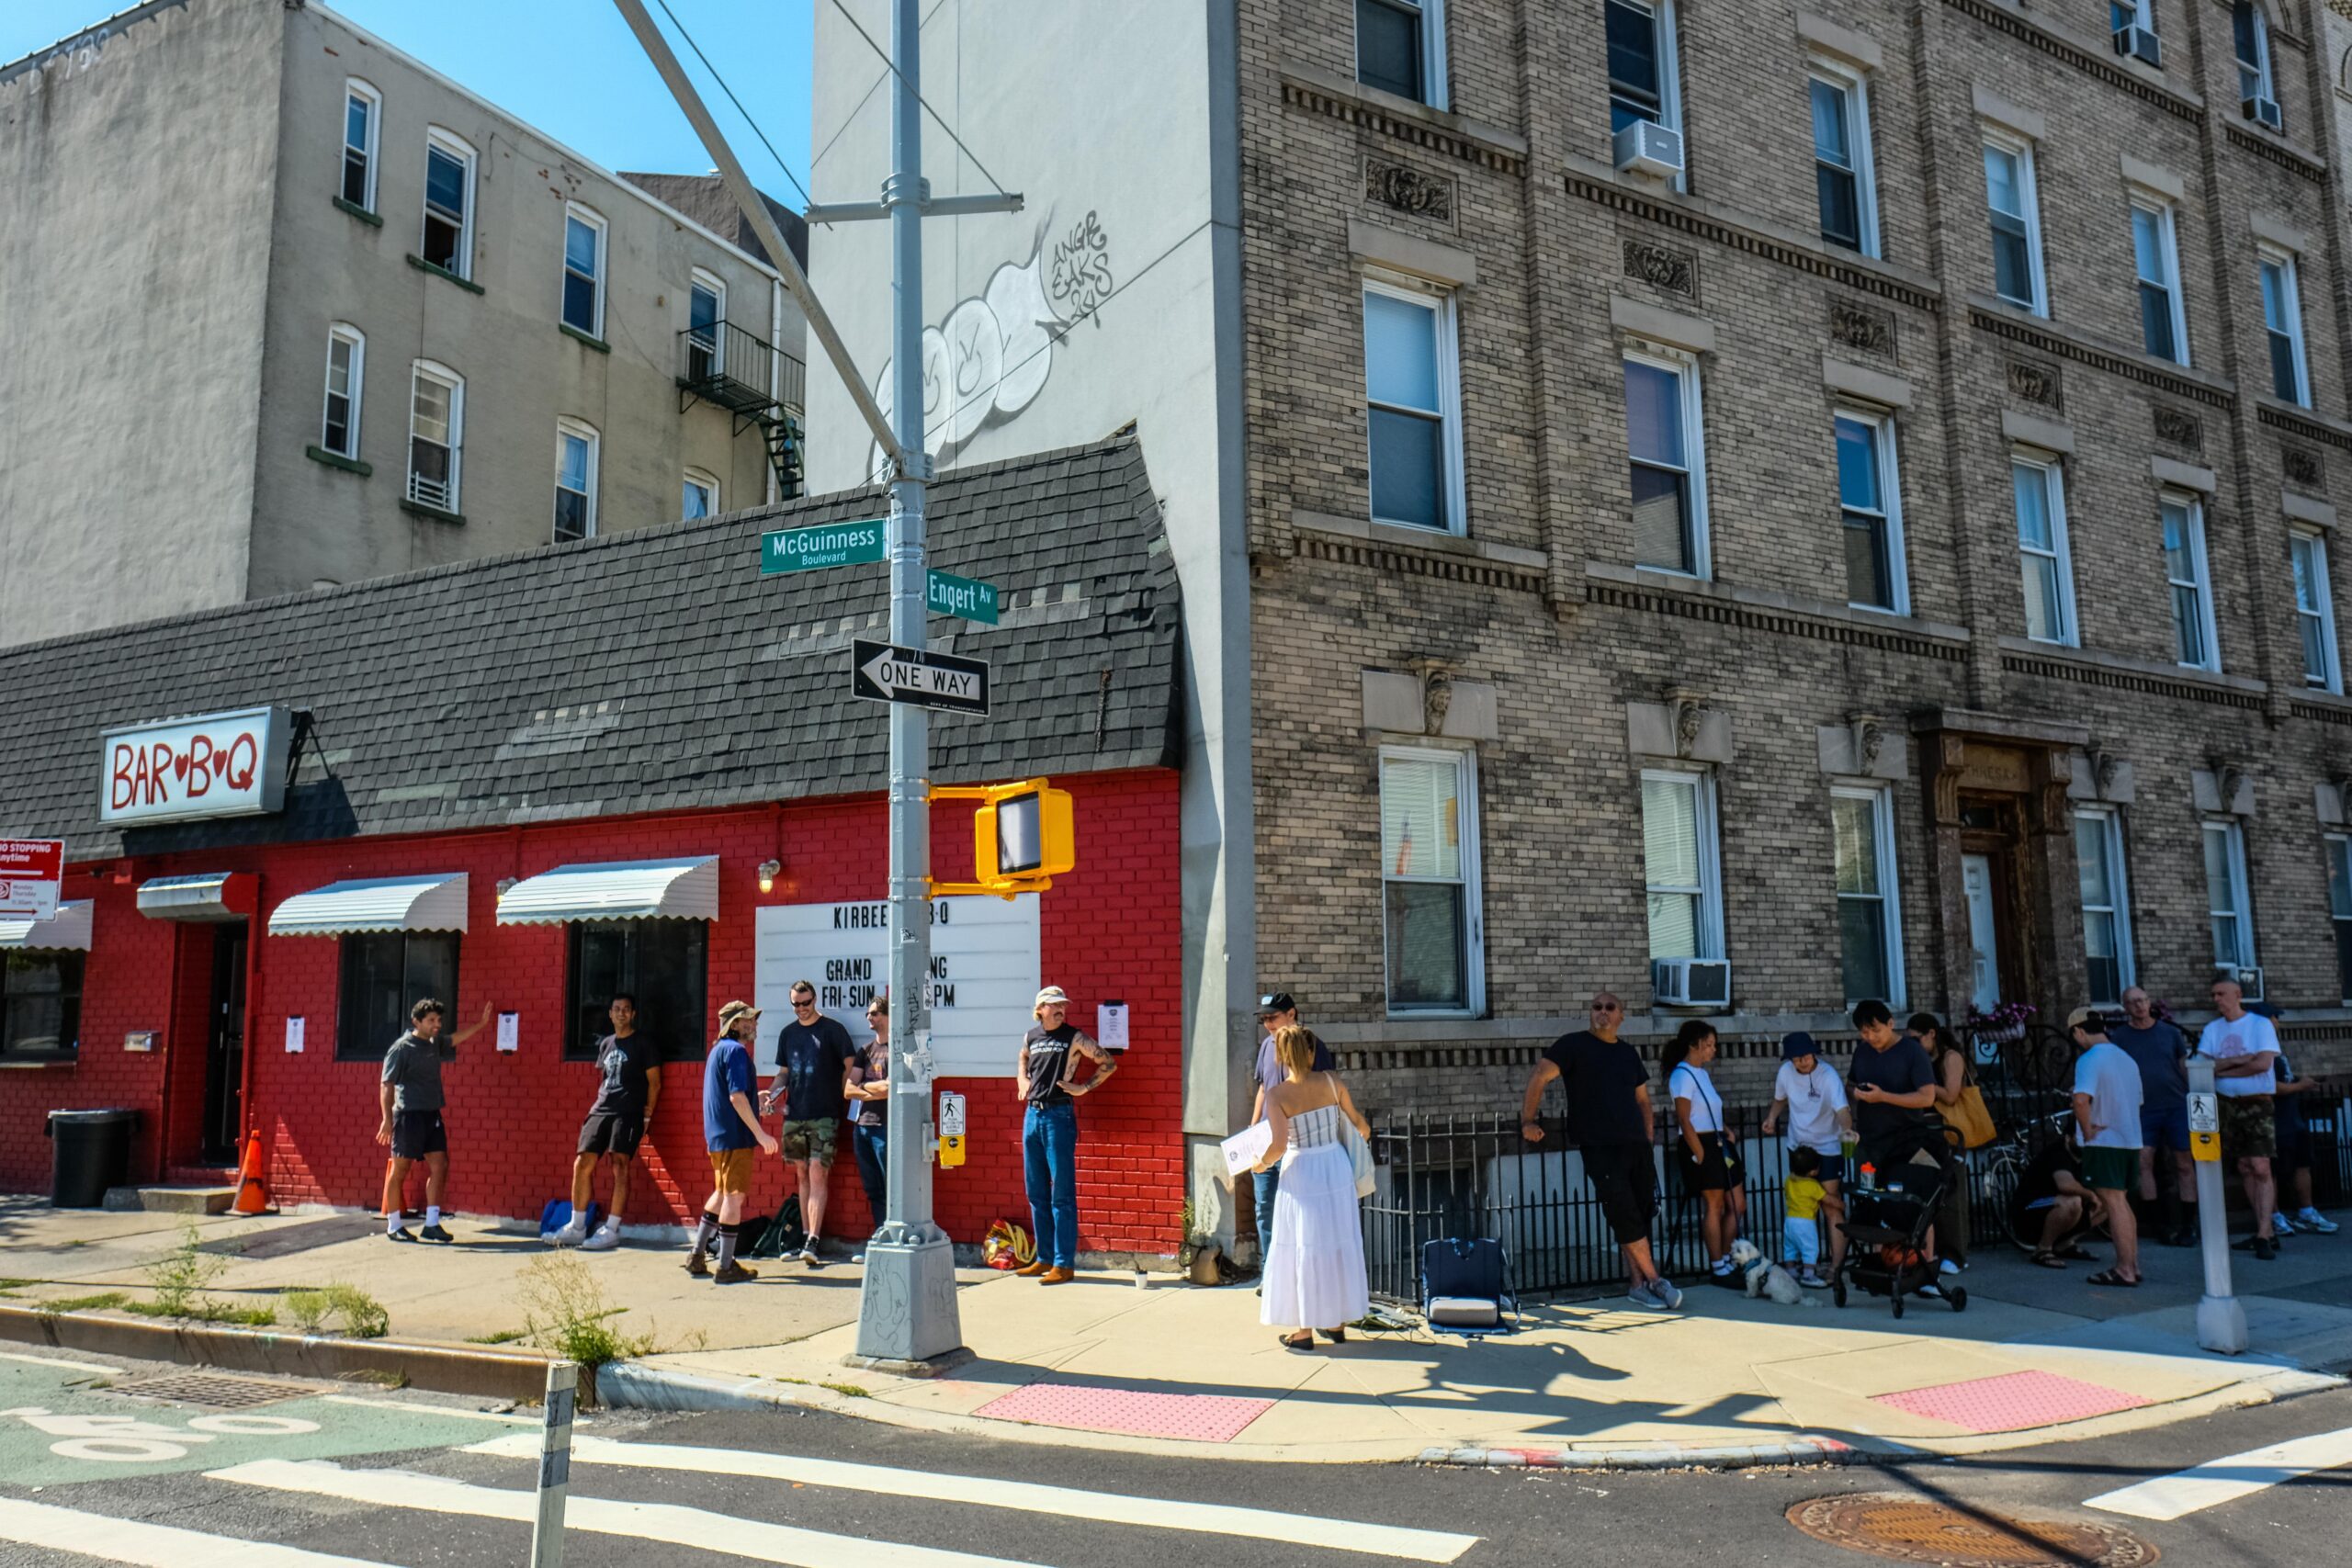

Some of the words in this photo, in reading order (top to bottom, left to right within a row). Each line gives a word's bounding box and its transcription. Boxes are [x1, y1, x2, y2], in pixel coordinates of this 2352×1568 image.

[773, 529, 876, 557] McGuinness
[801, 550, 846, 567] Boulevard
[929, 574, 976, 615] Engert
[979, 585, 991, 604] Av
[880, 661, 922, 688] ONE
[933, 670, 971, 695] WAY
[112, 742, 173, 810] BAR
[0, 853, 30, 863] nytime
[9, 843, 51, 853] STOPPING
[833, 904, 888, 930] KIRBEE
[826, 958, 872, 982] GRAND
